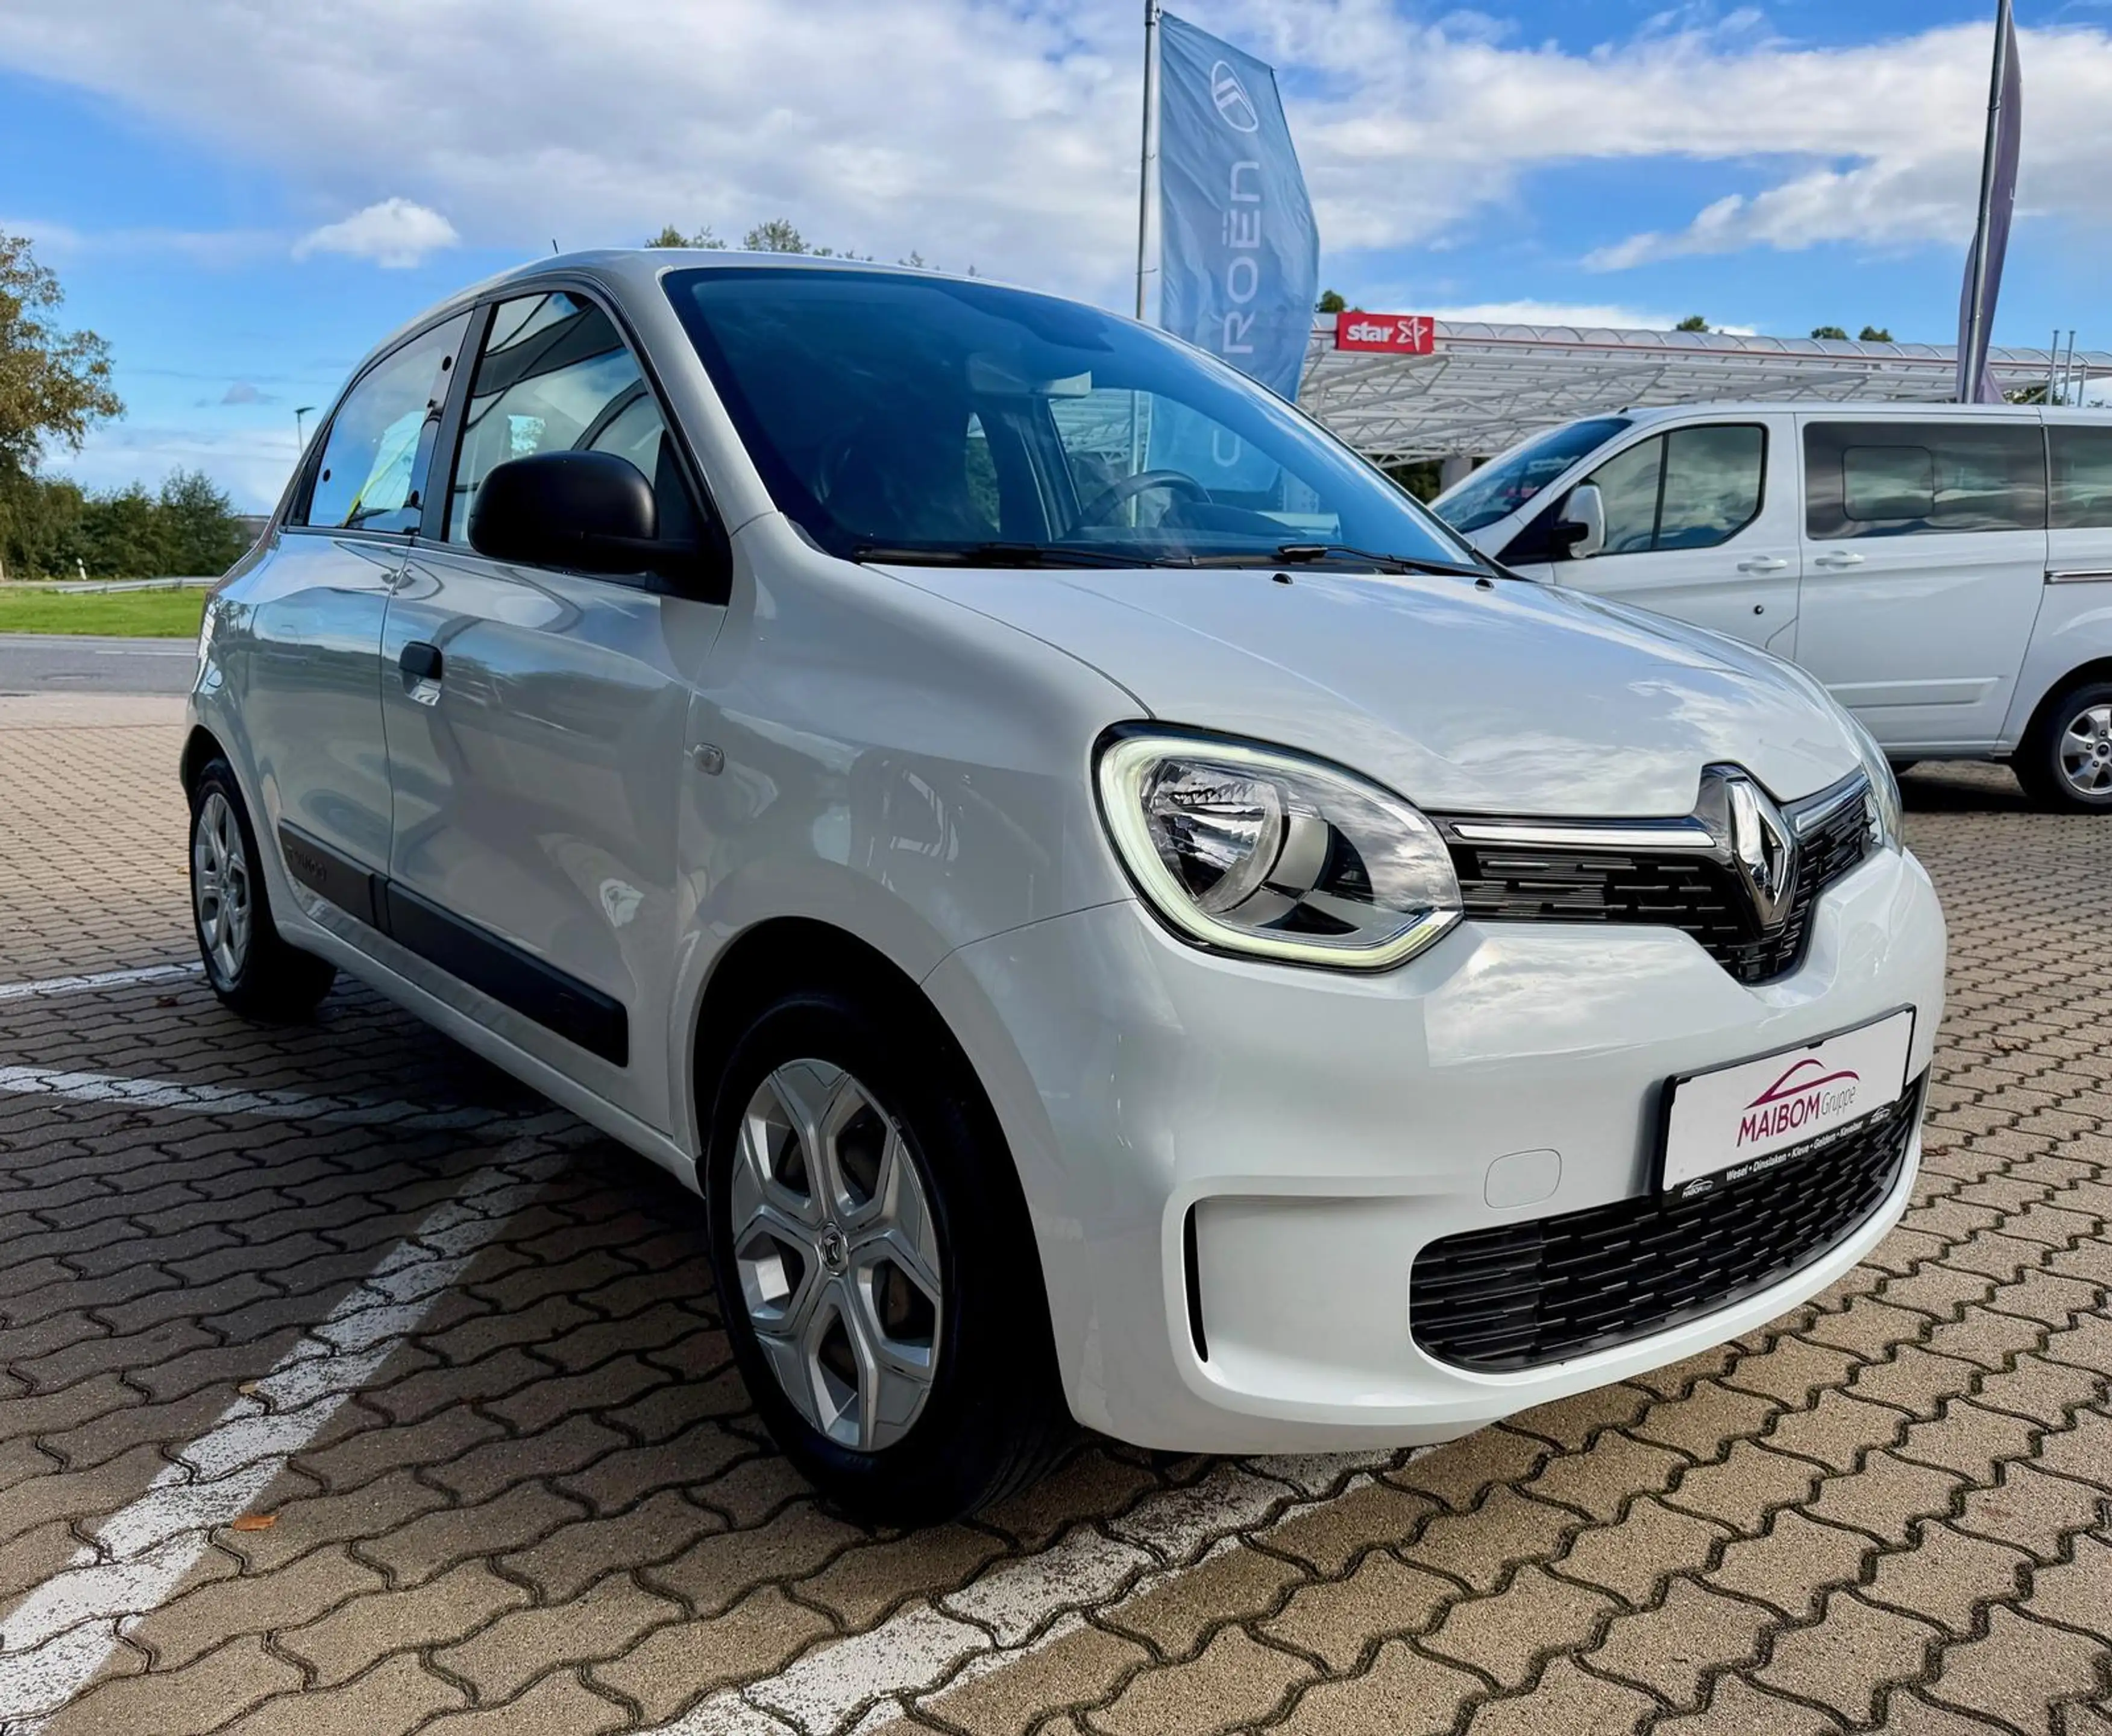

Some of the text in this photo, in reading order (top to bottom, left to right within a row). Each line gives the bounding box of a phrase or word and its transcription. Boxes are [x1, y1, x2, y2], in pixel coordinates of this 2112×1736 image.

[1347, 321, 1394, 342] star
[1736, 1086, 1856, 1148] MAIBOM Gruppe
